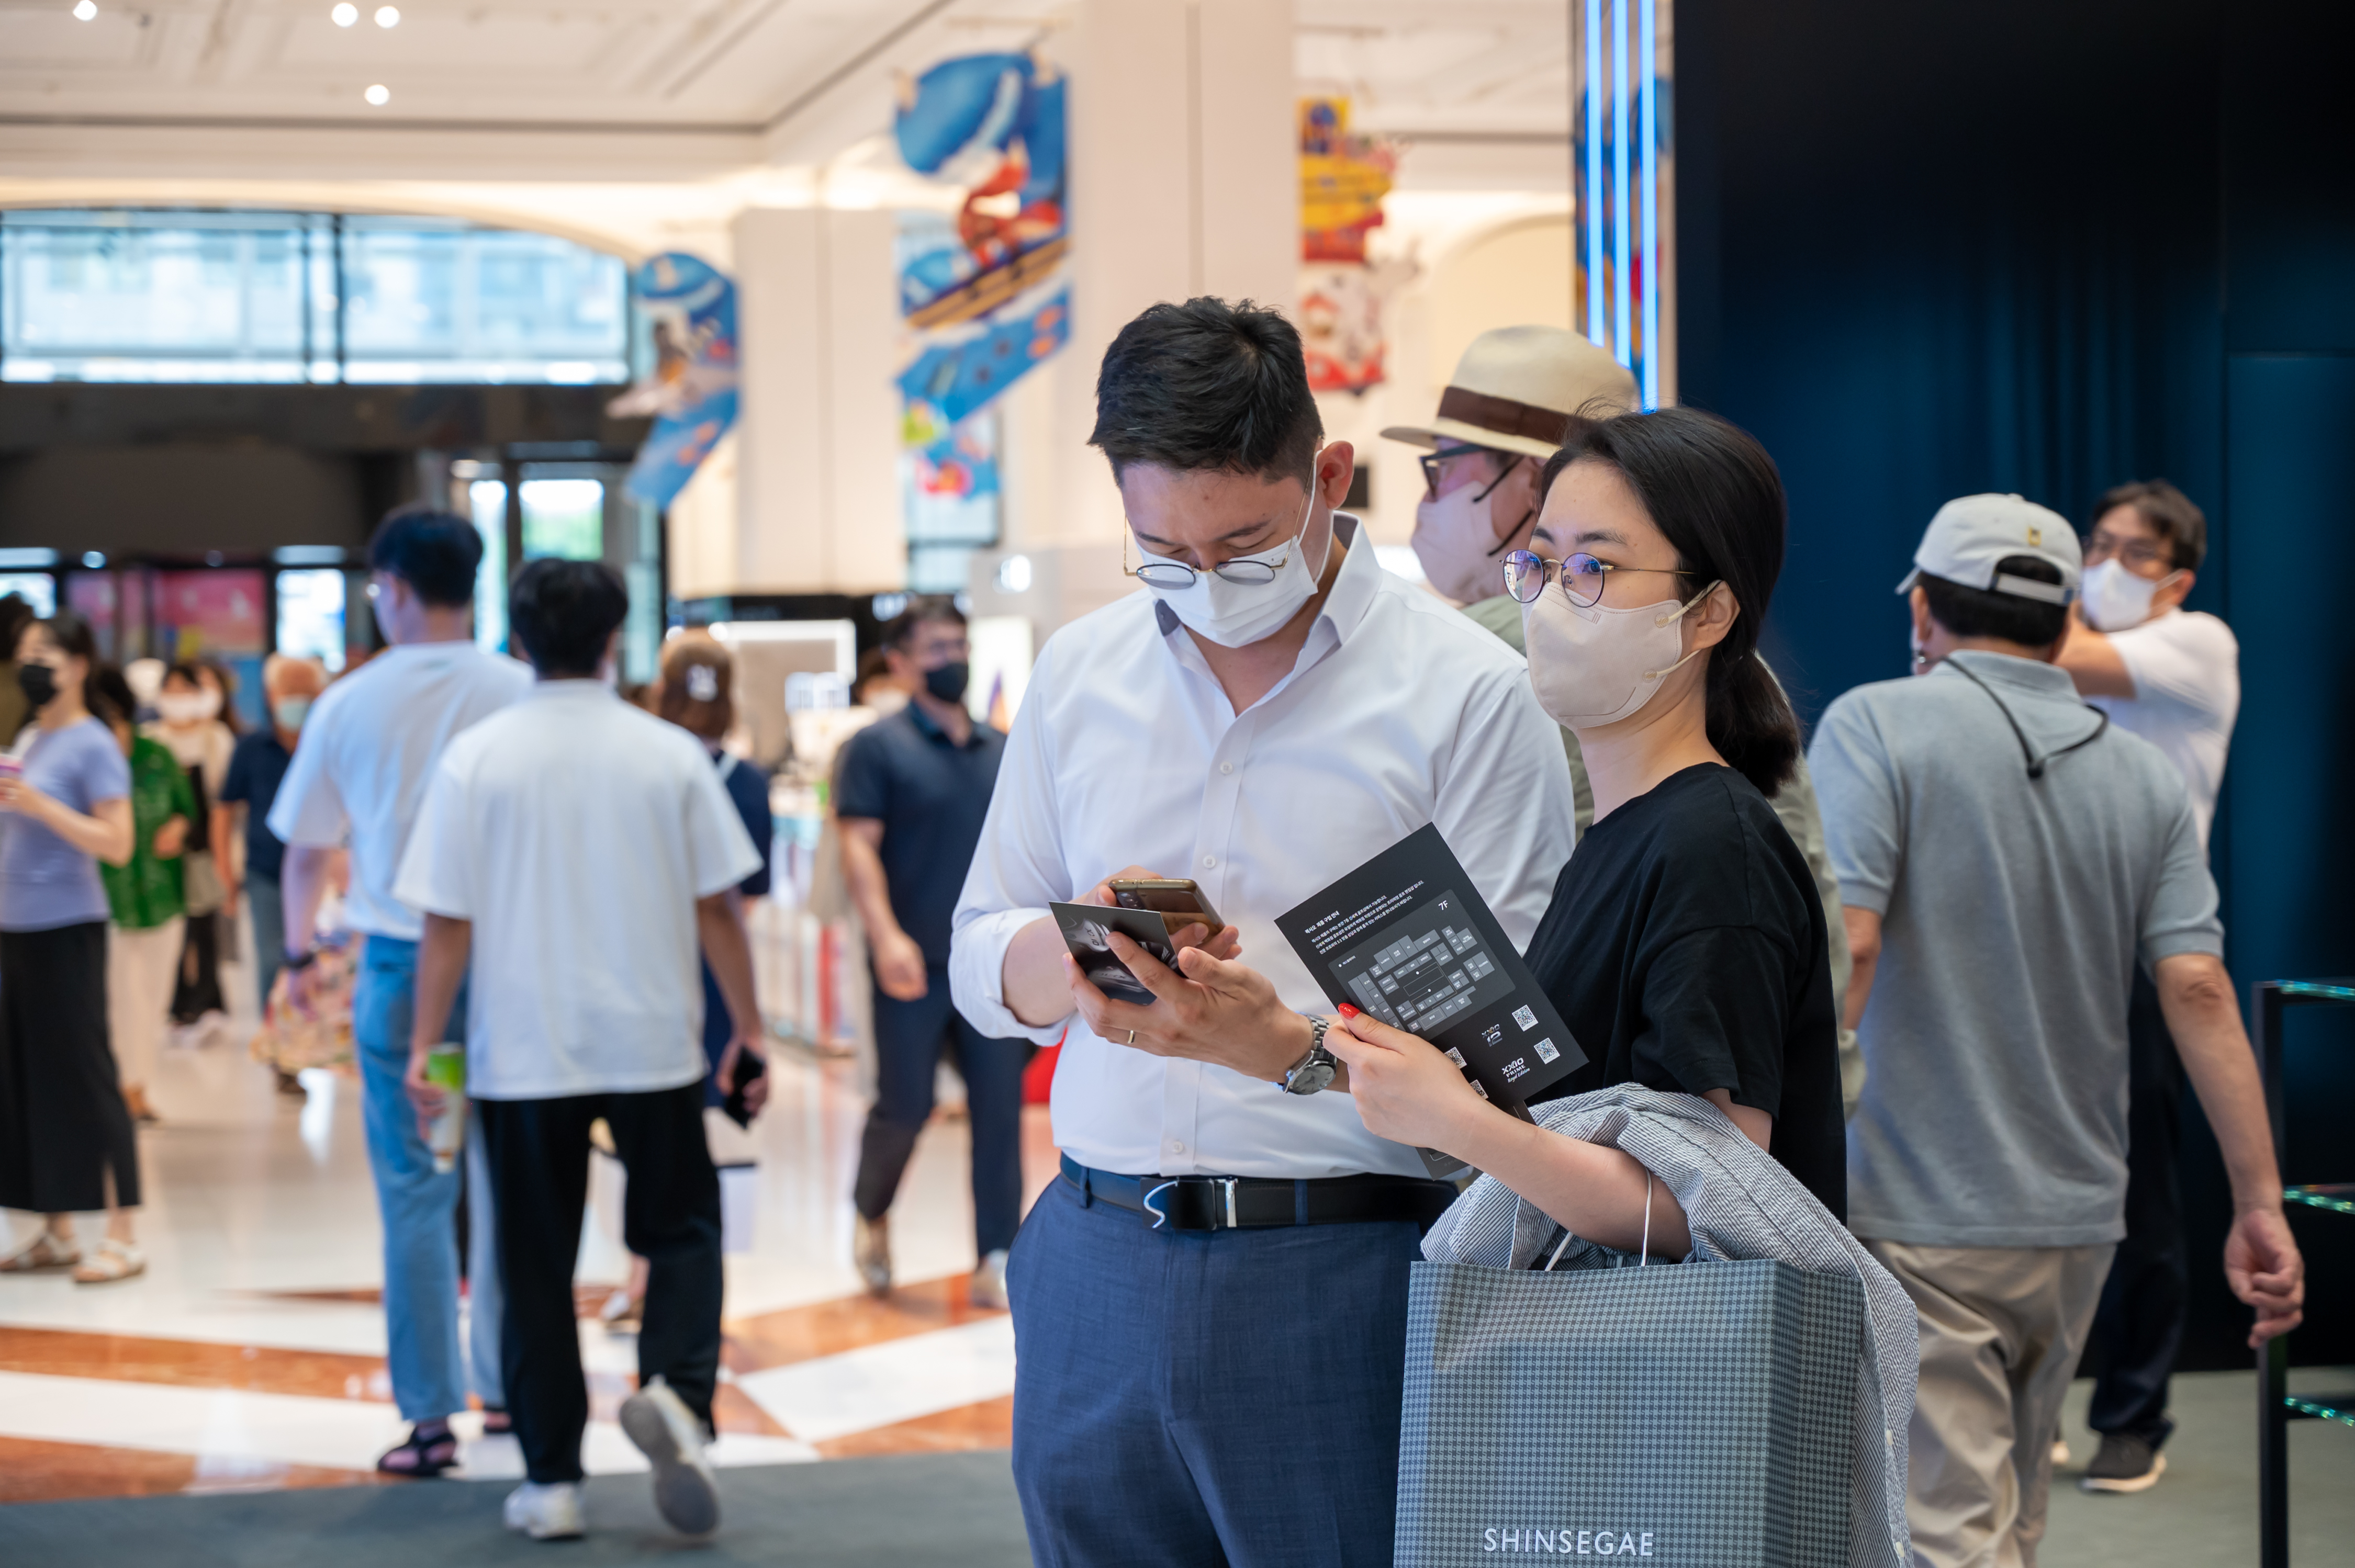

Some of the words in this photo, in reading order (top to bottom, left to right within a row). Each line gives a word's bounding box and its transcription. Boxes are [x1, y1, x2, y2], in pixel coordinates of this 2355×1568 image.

[1439, 900, 1448, 910] 7F
[1482, 1024, 1499, 1038] XXIO
[1487, 1031, 1502, 1046] 12
[1502, 1058, 1523, 1074] XXIO
[1506, 1064, 1526, 1077] PRIME
[1508, 1074, 1517, 1083] Royal
[1516, 1068, 1530, 1077] Edition
[1484, 1528, 1654, 1556] SHINSEGAE
